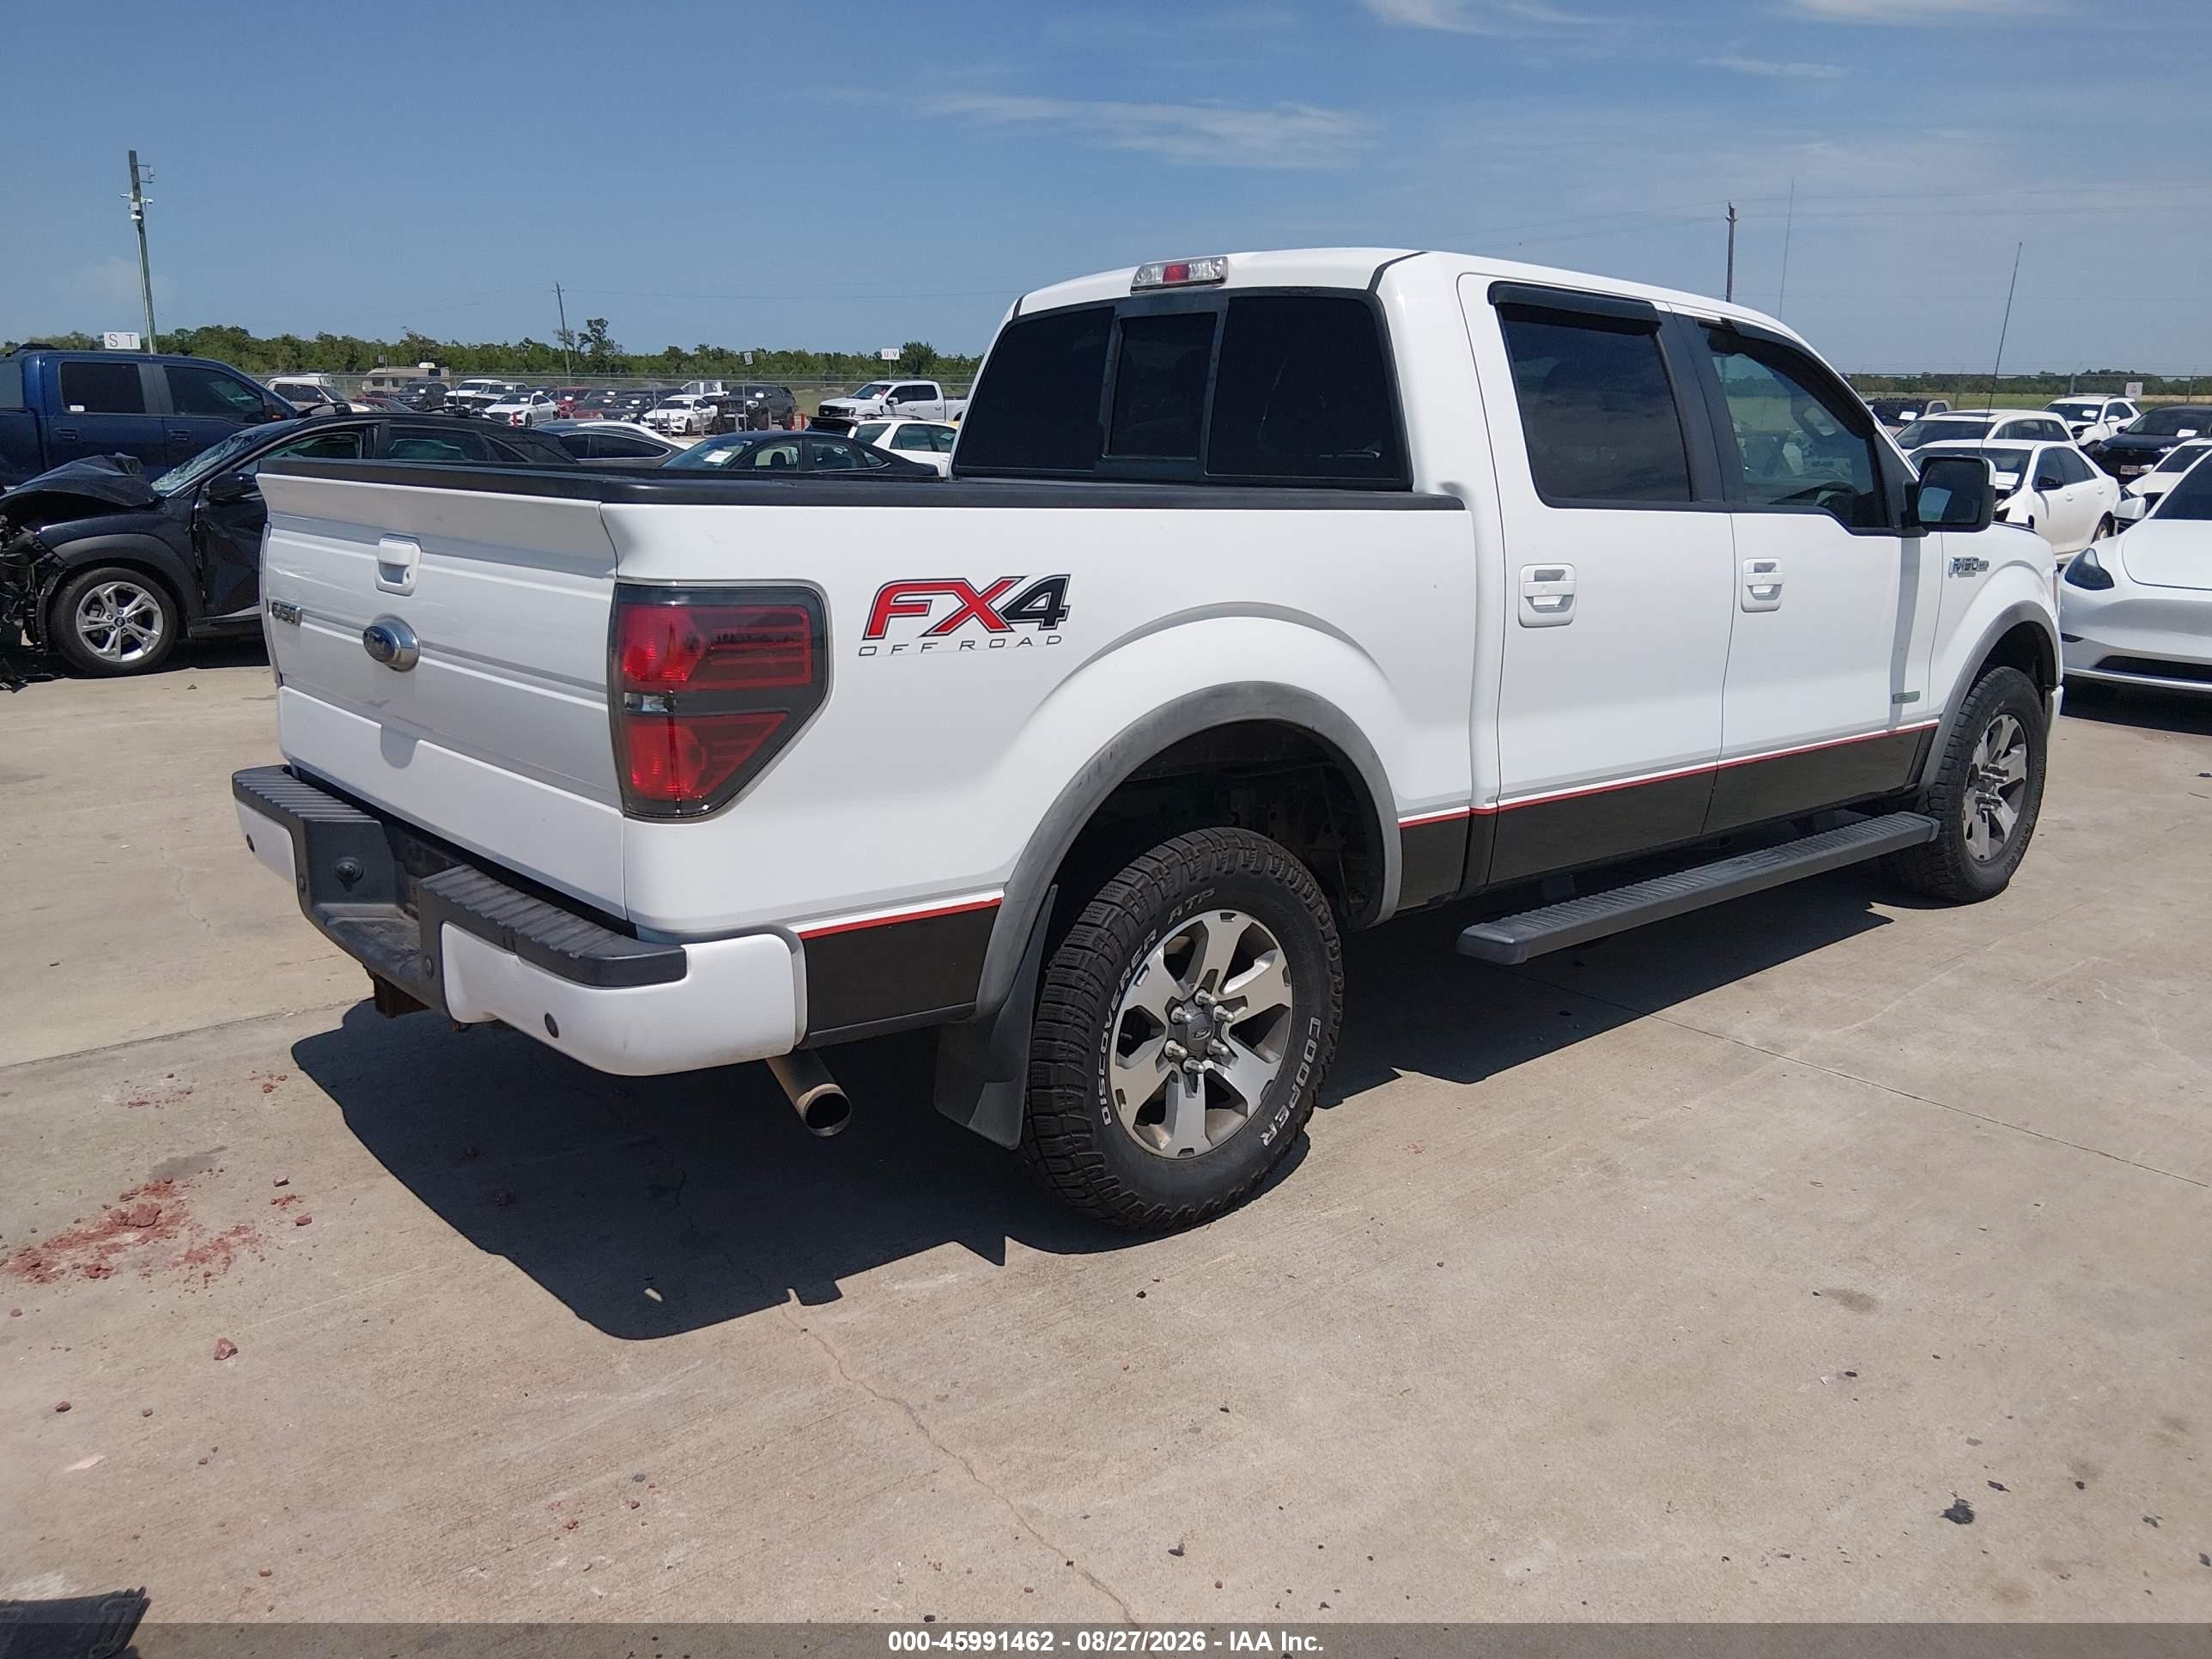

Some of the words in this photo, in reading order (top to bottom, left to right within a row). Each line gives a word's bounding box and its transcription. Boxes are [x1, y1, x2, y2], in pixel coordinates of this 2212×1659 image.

[109, 333, 118, 348] S
[125, 333, 135, 348] T
[861, 574, 1072, 641] FX4
[859, 641, 939, 656] OFF
[958, 635, 1062, 652] ROAD
[1098, 927, 1157, 1126] DISCOVERER
[1260, 1017, 1322, 1147] COOPER
